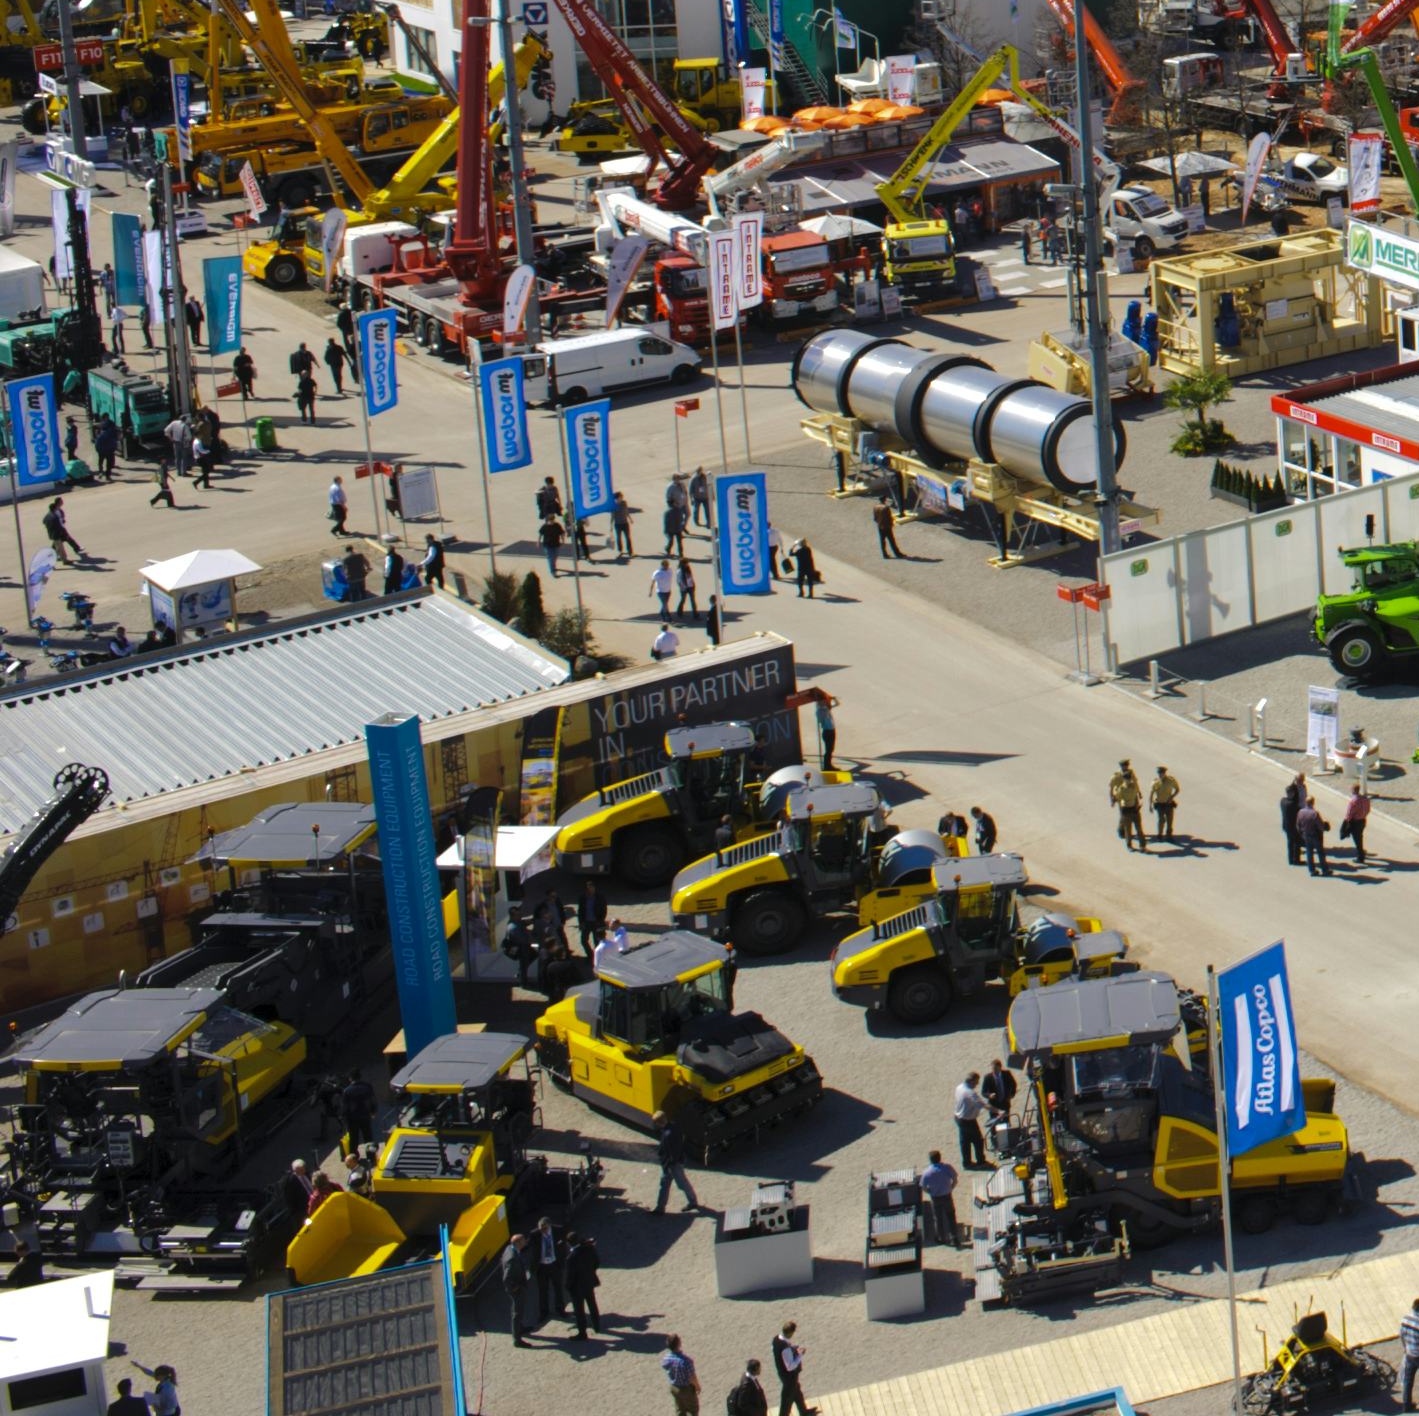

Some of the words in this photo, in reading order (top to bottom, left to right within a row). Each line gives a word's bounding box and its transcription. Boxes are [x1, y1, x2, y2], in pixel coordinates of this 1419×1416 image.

[594, 688, 666, 733] YOUR
[671, 659, 781, 714] PARTNER
[406, 744, 426, 829] EQUIPMENT
[599, 732, 625, 764] IN
[376, 752, 400, 832] EQUIPMENT
[386, 837, 414, 944] CONSTRUCTION
[416, 831, 439, 939] CONSTRUCTION
[1253, 984, 1277, 1053] Copco
[1253, 1052, 1276, 1117] Atlas
